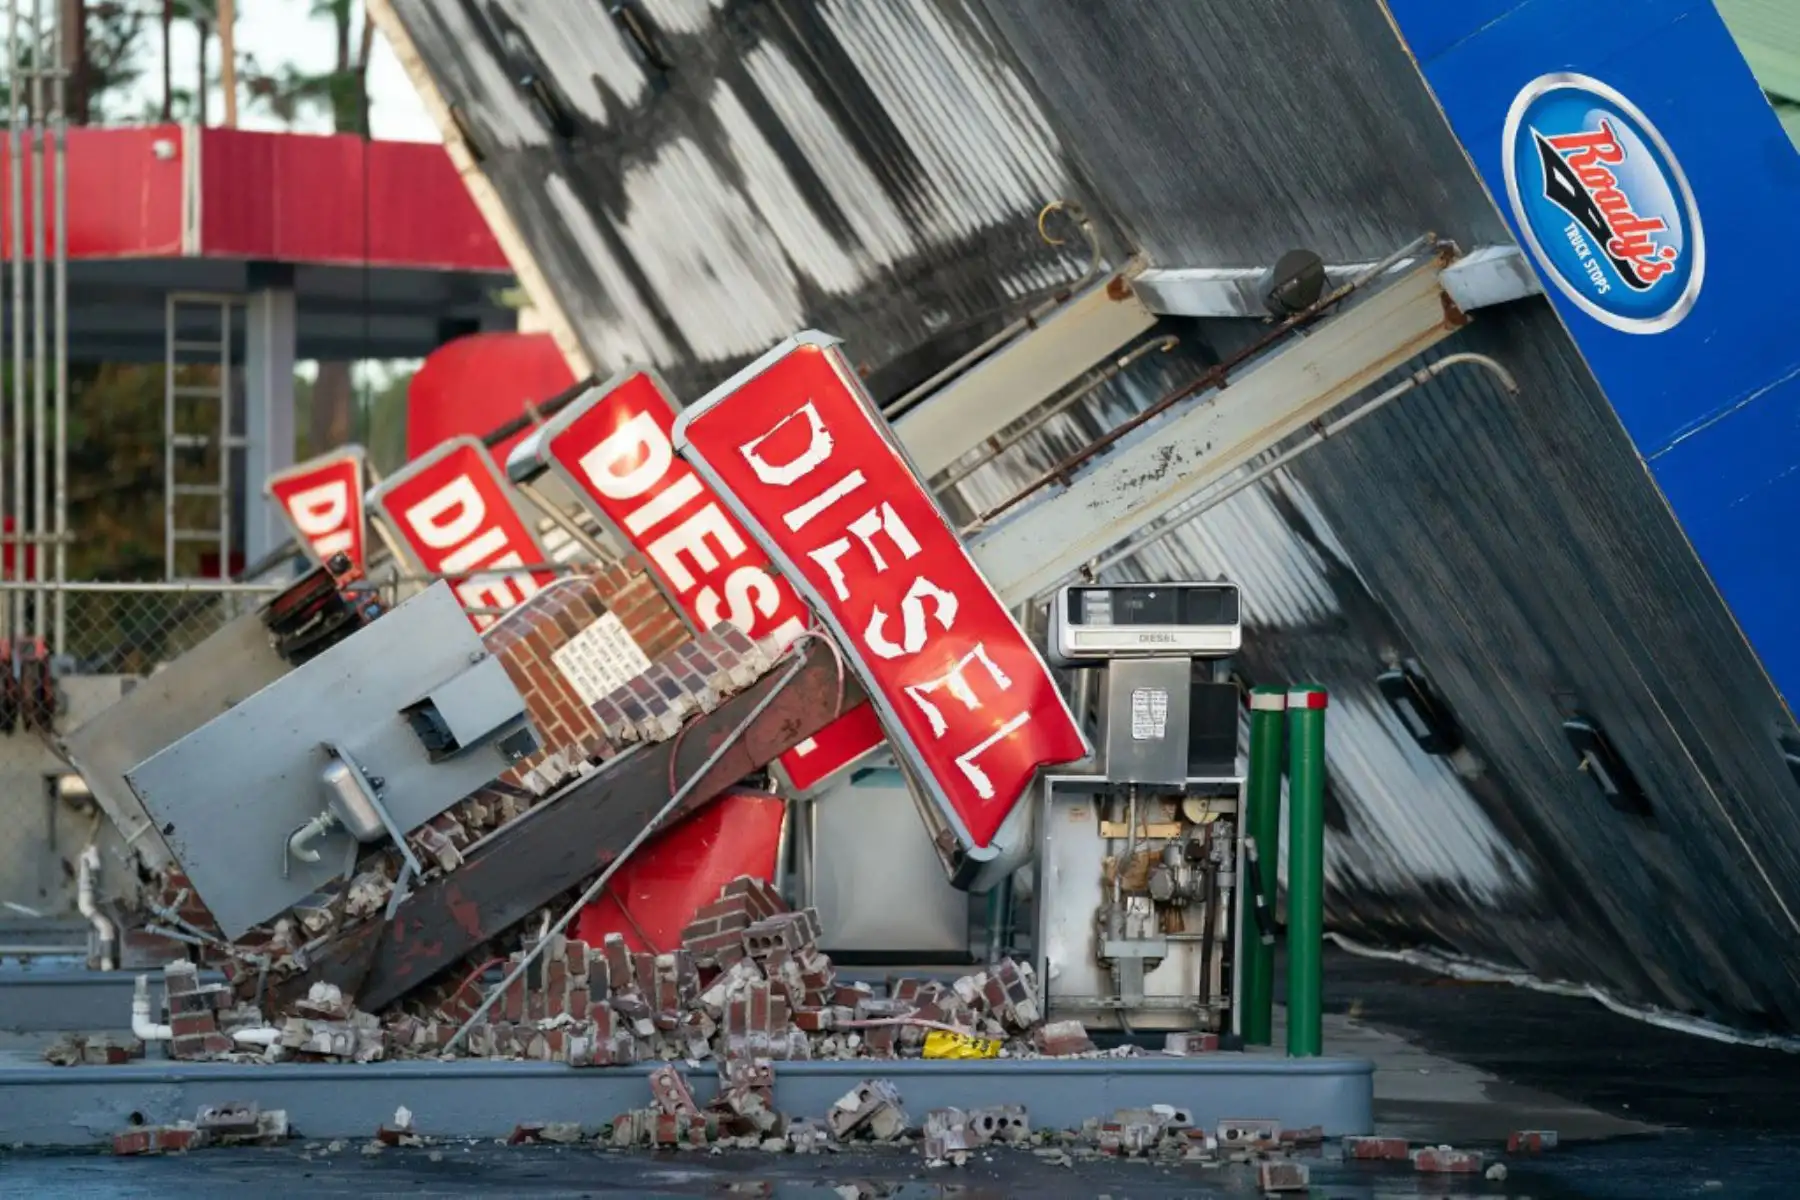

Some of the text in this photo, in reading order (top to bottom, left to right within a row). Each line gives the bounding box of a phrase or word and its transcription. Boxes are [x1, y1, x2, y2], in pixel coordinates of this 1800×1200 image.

[1547, 119, 1678, 284] Roady's
[1564, 221, 1611, 295] TRUCK STOPS
[579, 409, 819, 757] DIES
[739, 399, 1031, 800] DIESEL
[1139, 633, 1177, 643] DIESEL
